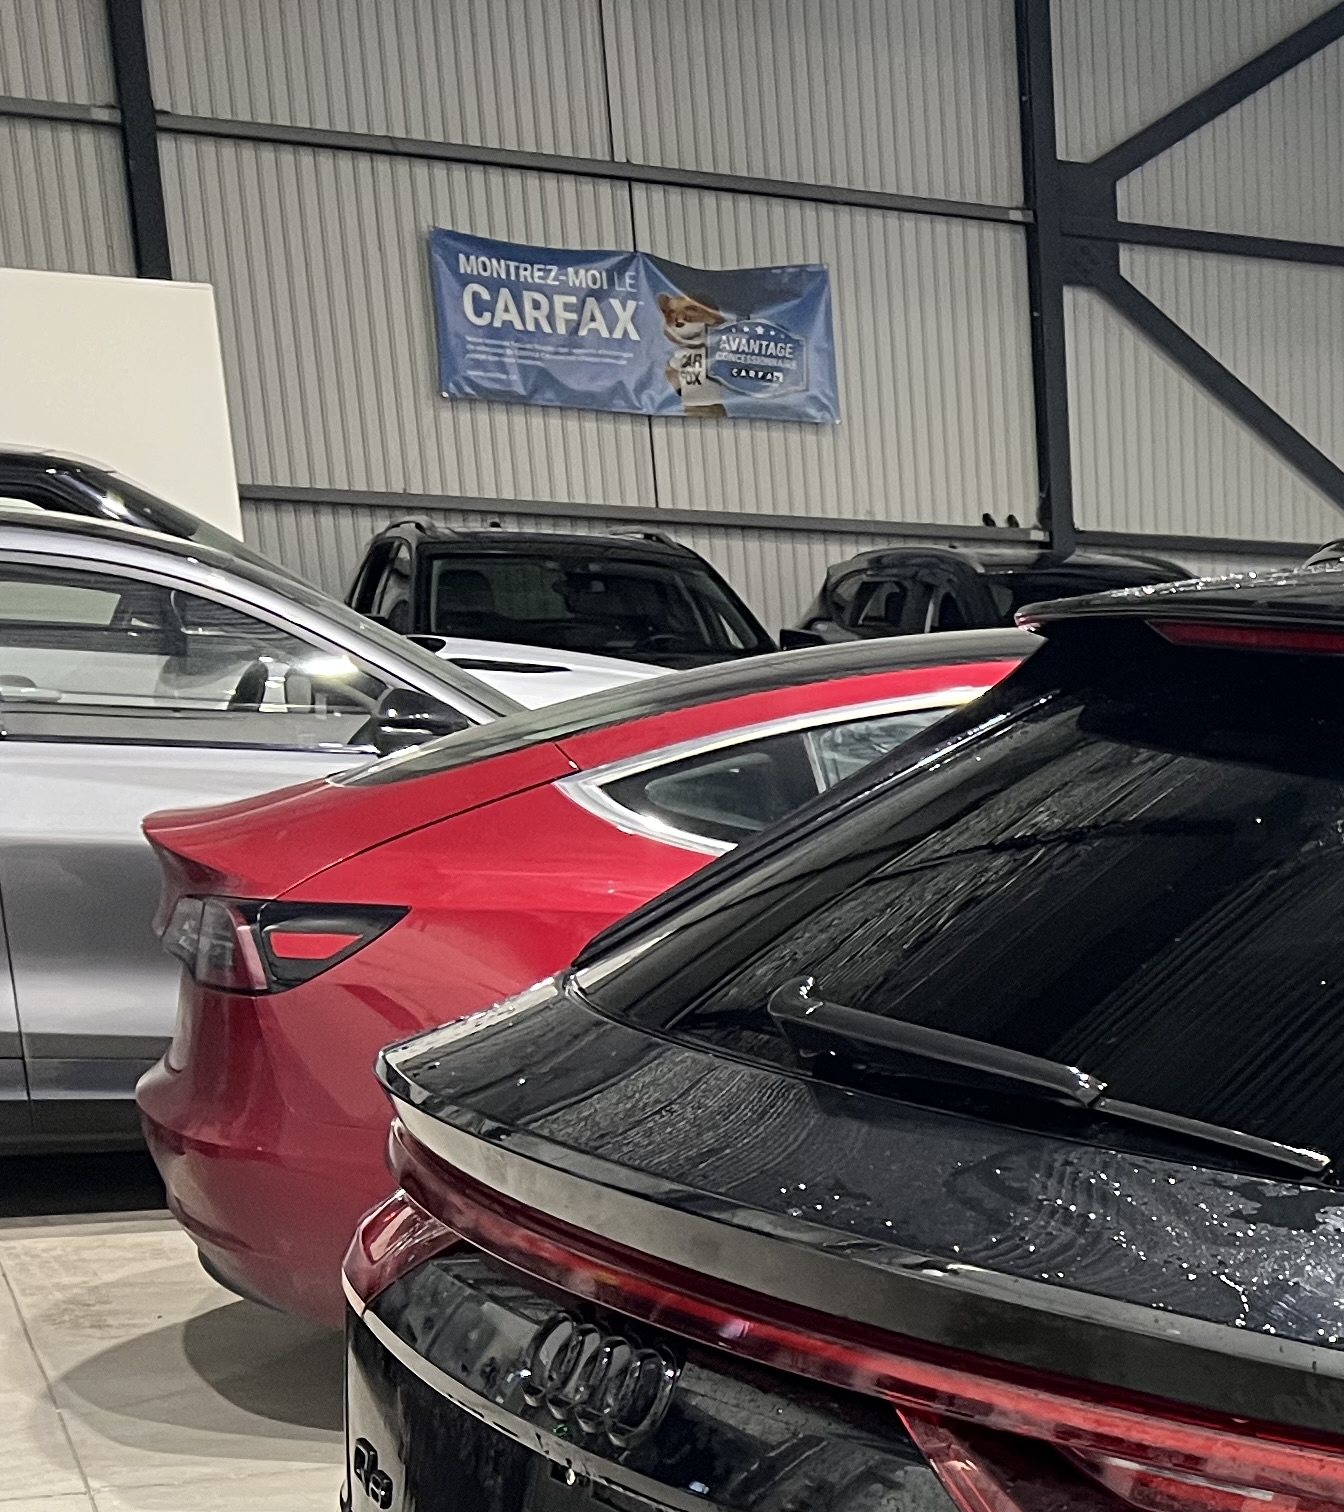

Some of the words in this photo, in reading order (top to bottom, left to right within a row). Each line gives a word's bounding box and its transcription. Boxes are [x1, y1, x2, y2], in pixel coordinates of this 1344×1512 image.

[459, 253, 608, 290] MONTREZ-MOI
[614, 271, 638, 293] LE
[462, 283, 641, 341] CARFAX
[720, 335, 794, 358] AVANTAGE
[354, 1437, 393, 1509] Q8
